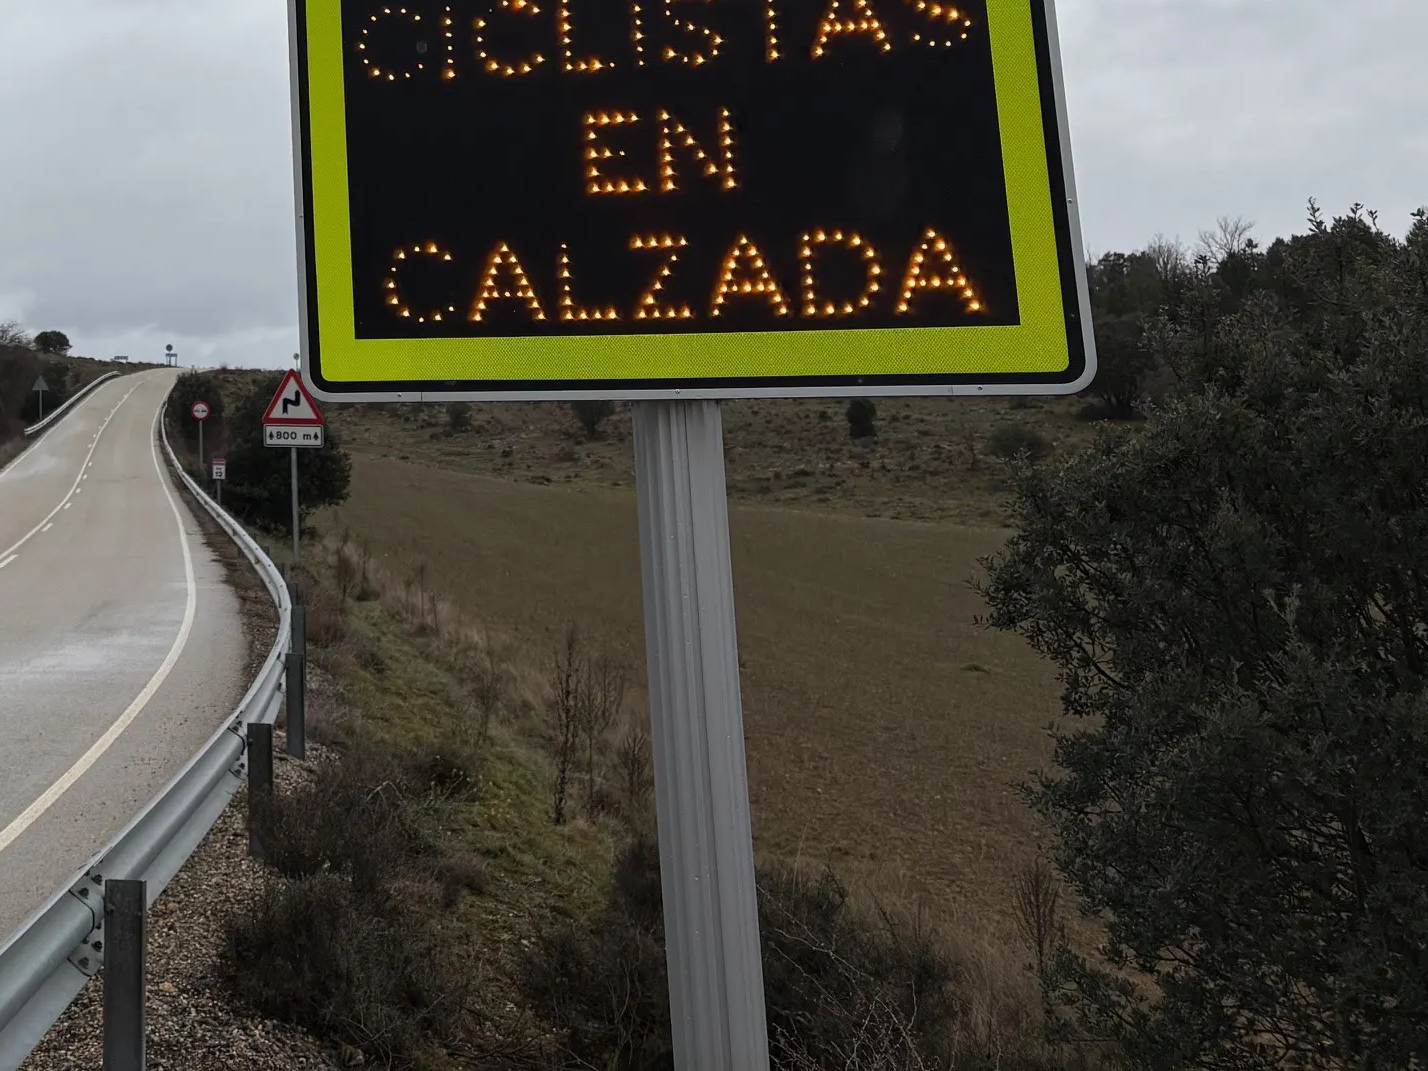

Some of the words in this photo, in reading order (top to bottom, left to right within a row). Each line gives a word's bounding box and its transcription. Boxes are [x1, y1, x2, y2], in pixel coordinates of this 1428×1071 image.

[583, 106, 742, 196] EN
[384, 226, 985, 324] CALZADA
[276, 431, 297, 440] 800
